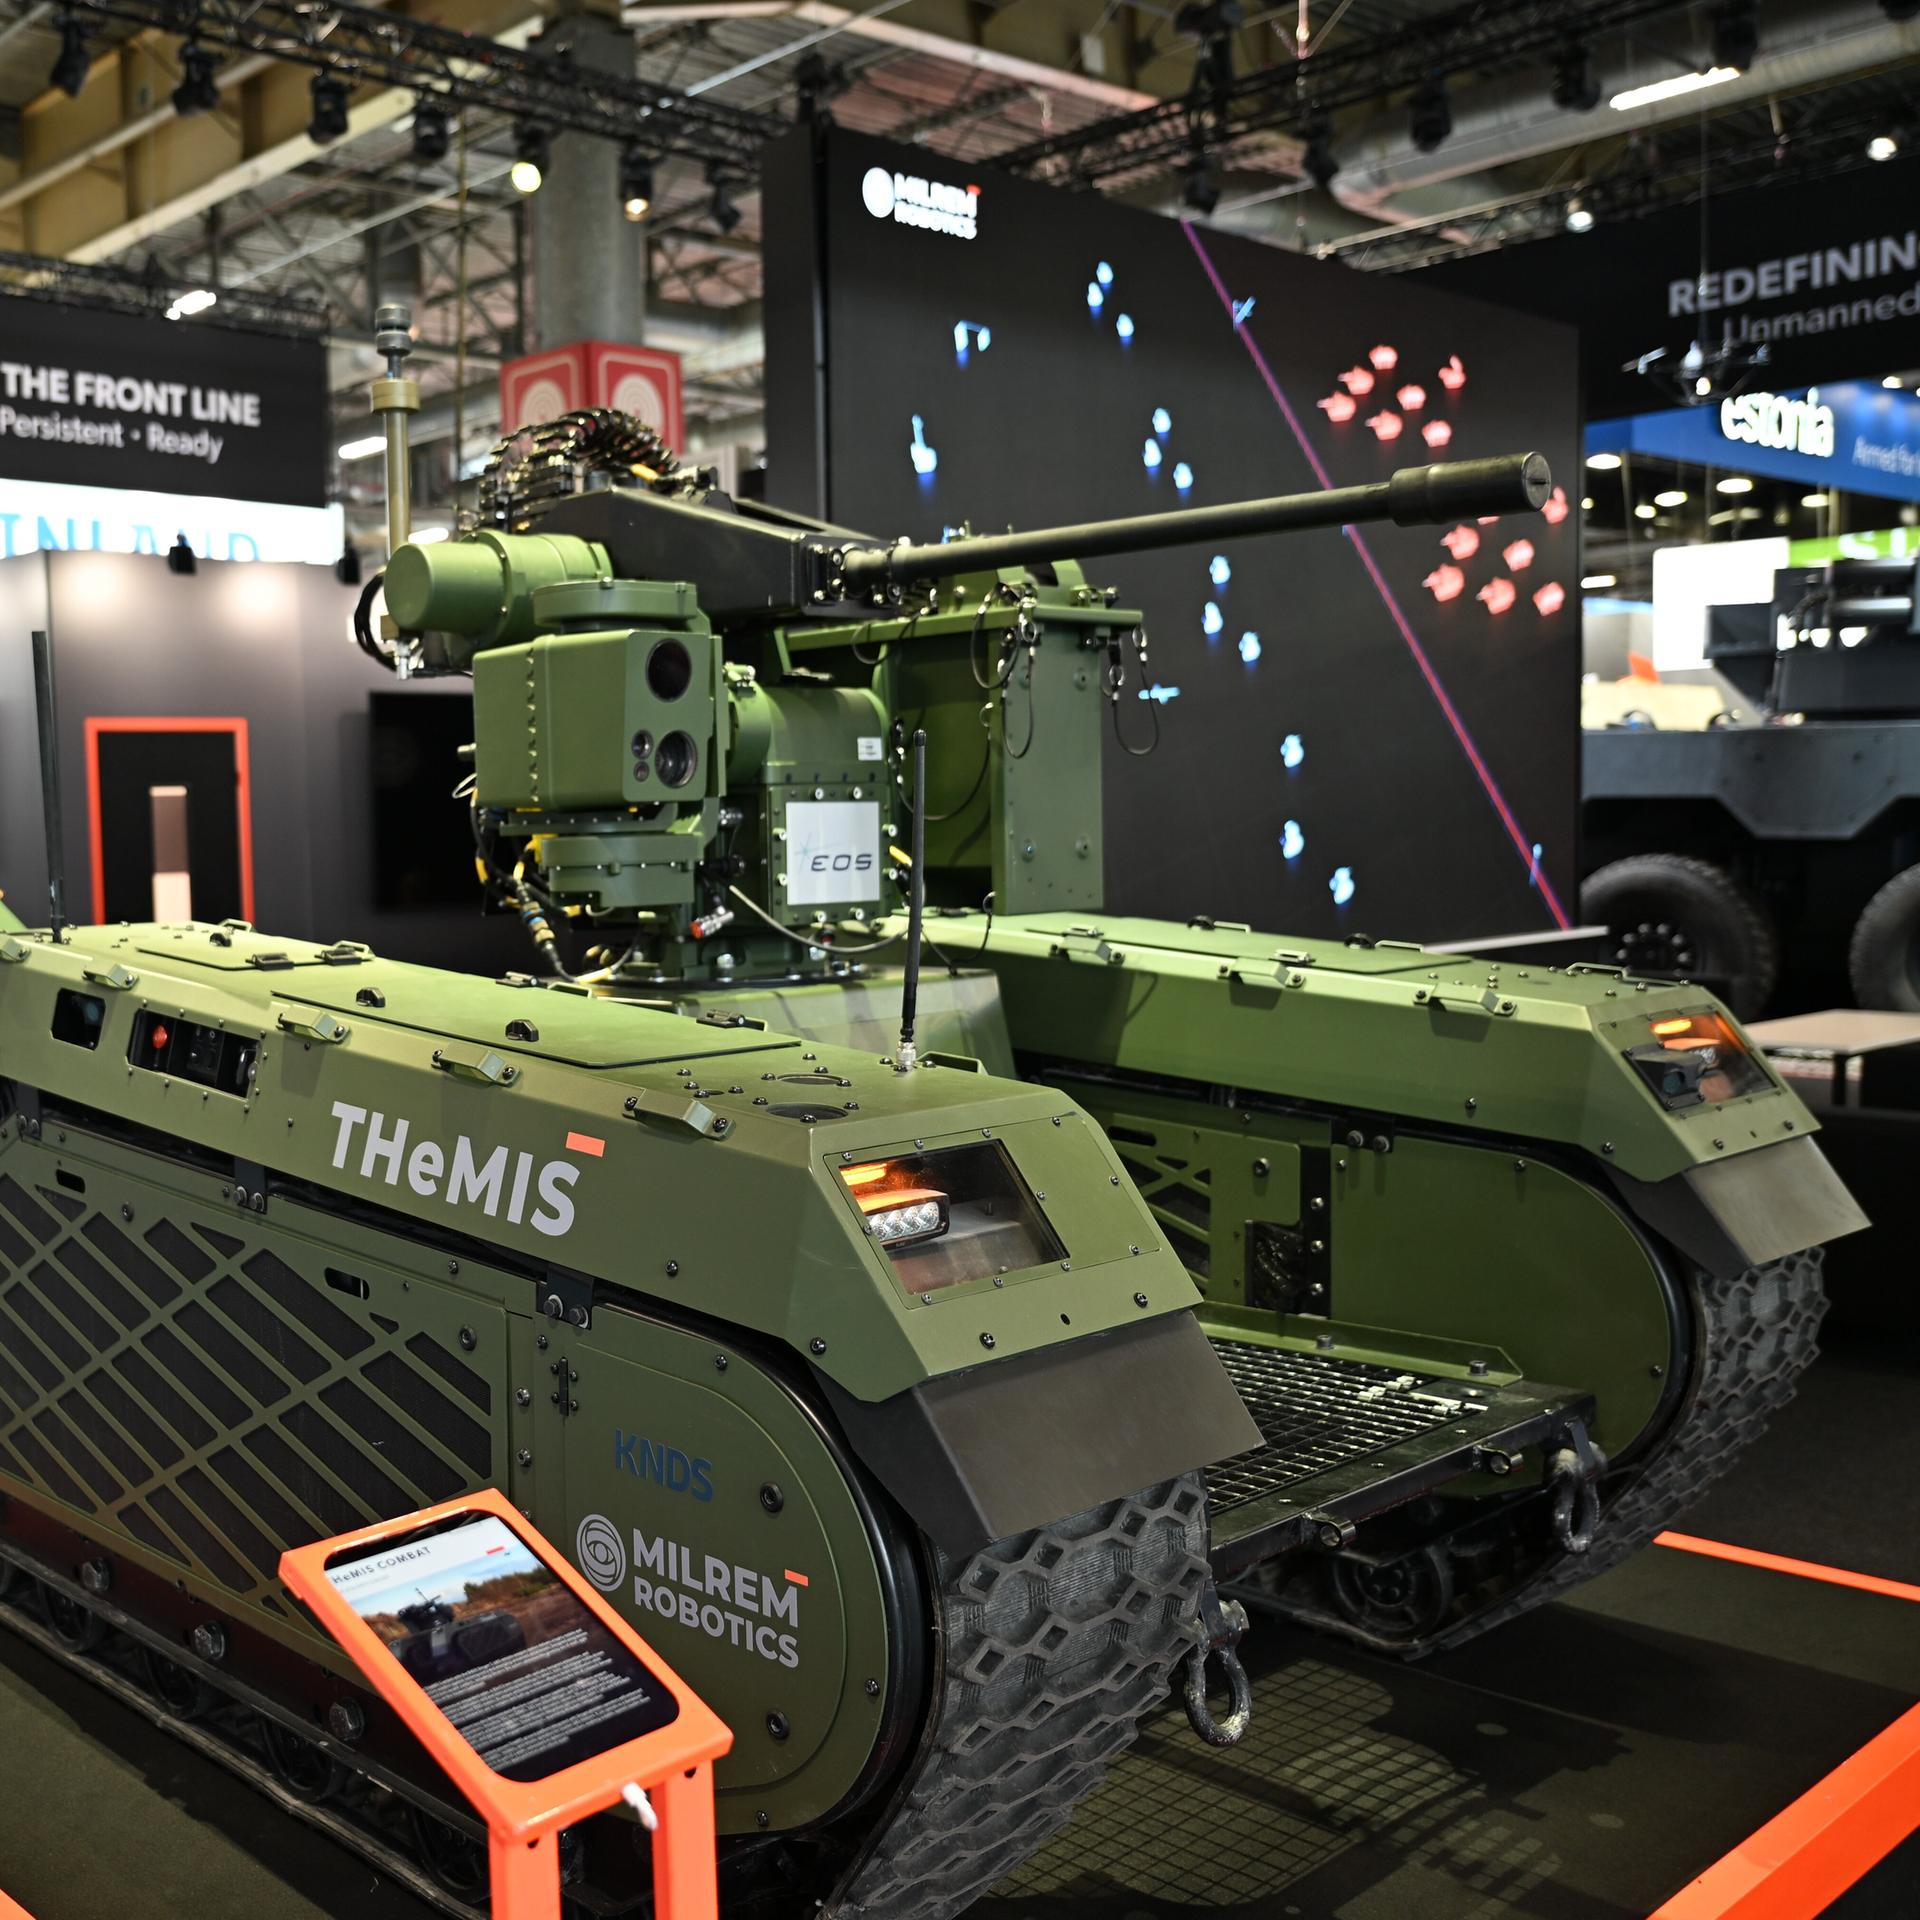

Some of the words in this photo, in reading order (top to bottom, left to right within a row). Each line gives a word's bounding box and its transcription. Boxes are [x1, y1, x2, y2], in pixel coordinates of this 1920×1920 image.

[1668, 231, 1920, 317] REDEFININ
[1723, 281, 1920, 342] Unmanned
[0, 361, 70, 404] THE
[75, 370, 188, 417] FRONT
[191, 384, 262, 428] LINE
[1721, 386, 1834, 458] estonia
[0, 404, 125, 448] Persistent
[145, 421, 224, 464] Ready
[811, 853, 872, 872] EOS
[331, 1101, 580, 1236] THeMIS
[615, 1427, 714, 1502] KNDS
[377, 1546, 432, 1569] COMBAT
[633, 1528, 799, 1628] MILREM
[634, 1575, 799, 1669] ROBOTICS
